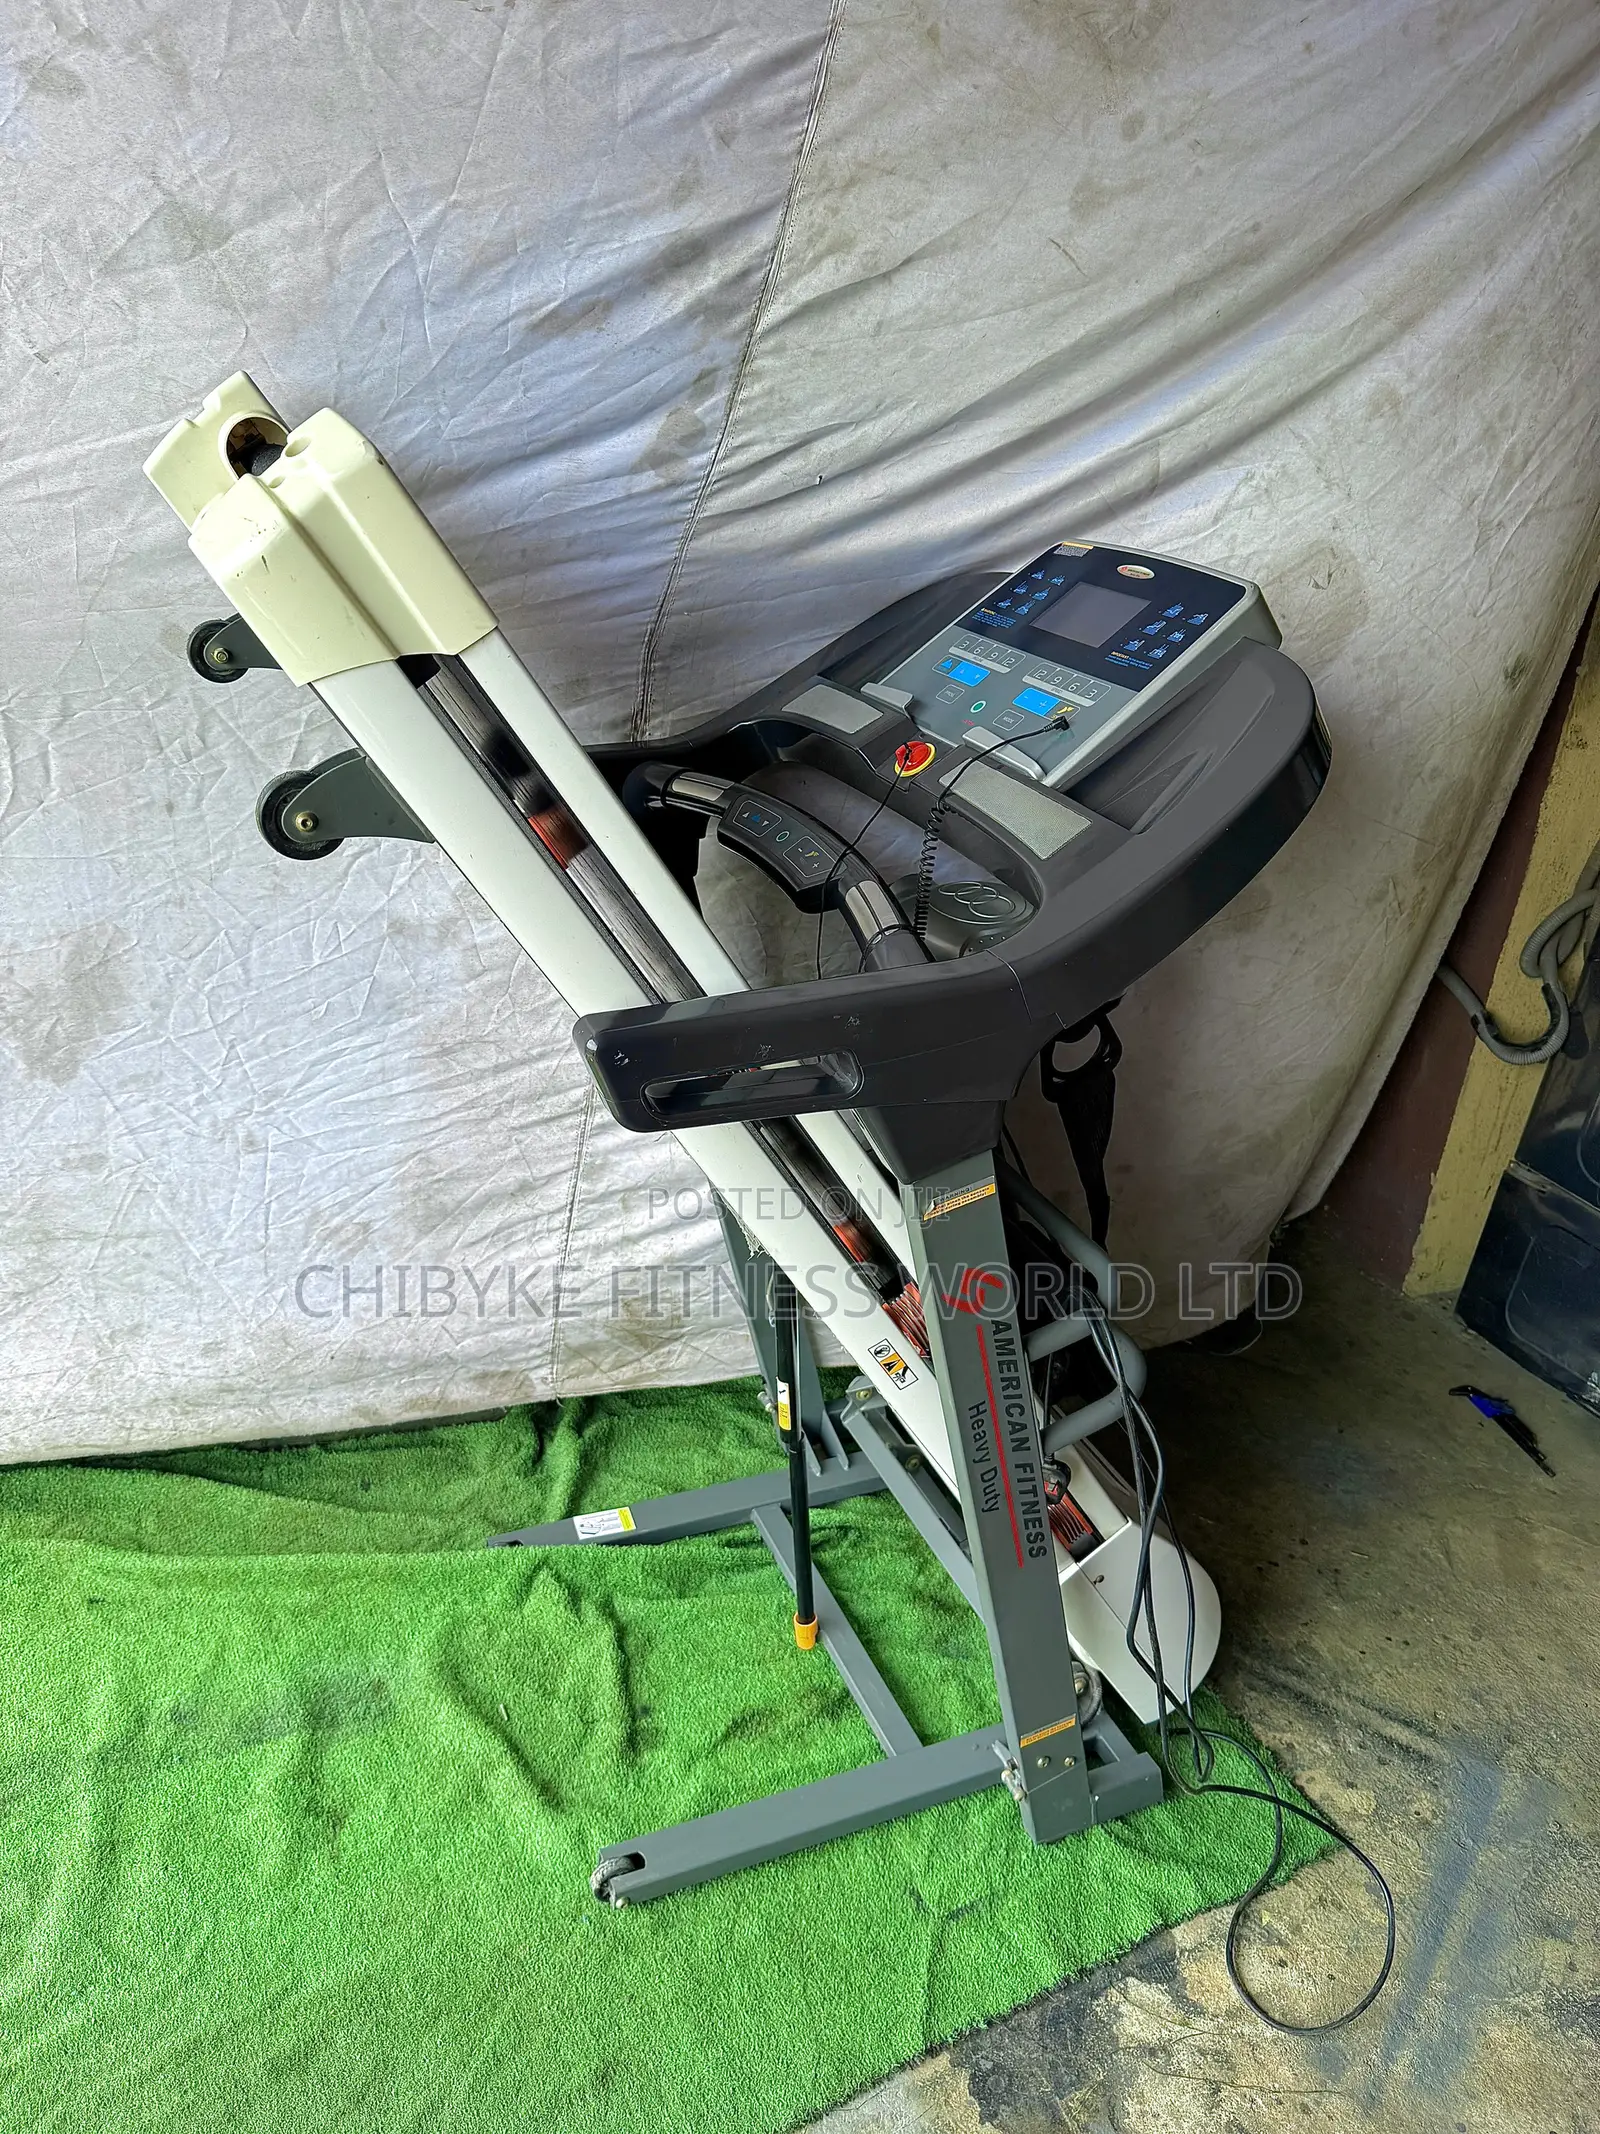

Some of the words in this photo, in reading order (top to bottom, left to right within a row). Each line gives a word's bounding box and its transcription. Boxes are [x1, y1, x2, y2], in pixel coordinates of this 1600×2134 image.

[958, 640, 970, 649] 3
[973, 646, 985, 655] 6
[987, 652, 999, 660] 9
[1001, 656, 1016, 667] 12
[1032, 669, 1048, 679] 12
[1050, 676, 1063, 685] 9
[1068, 682, 1080, 692] 6
[1085, 688, 1098, 698] 3
[968, 1400, 992, 1464] Heavy
[980, 1465, 1000, 1513] Duty
[991, 1319, 1031, 1453] AMERICAN
[1014, 1462, 1048, 1559] FITNESS
